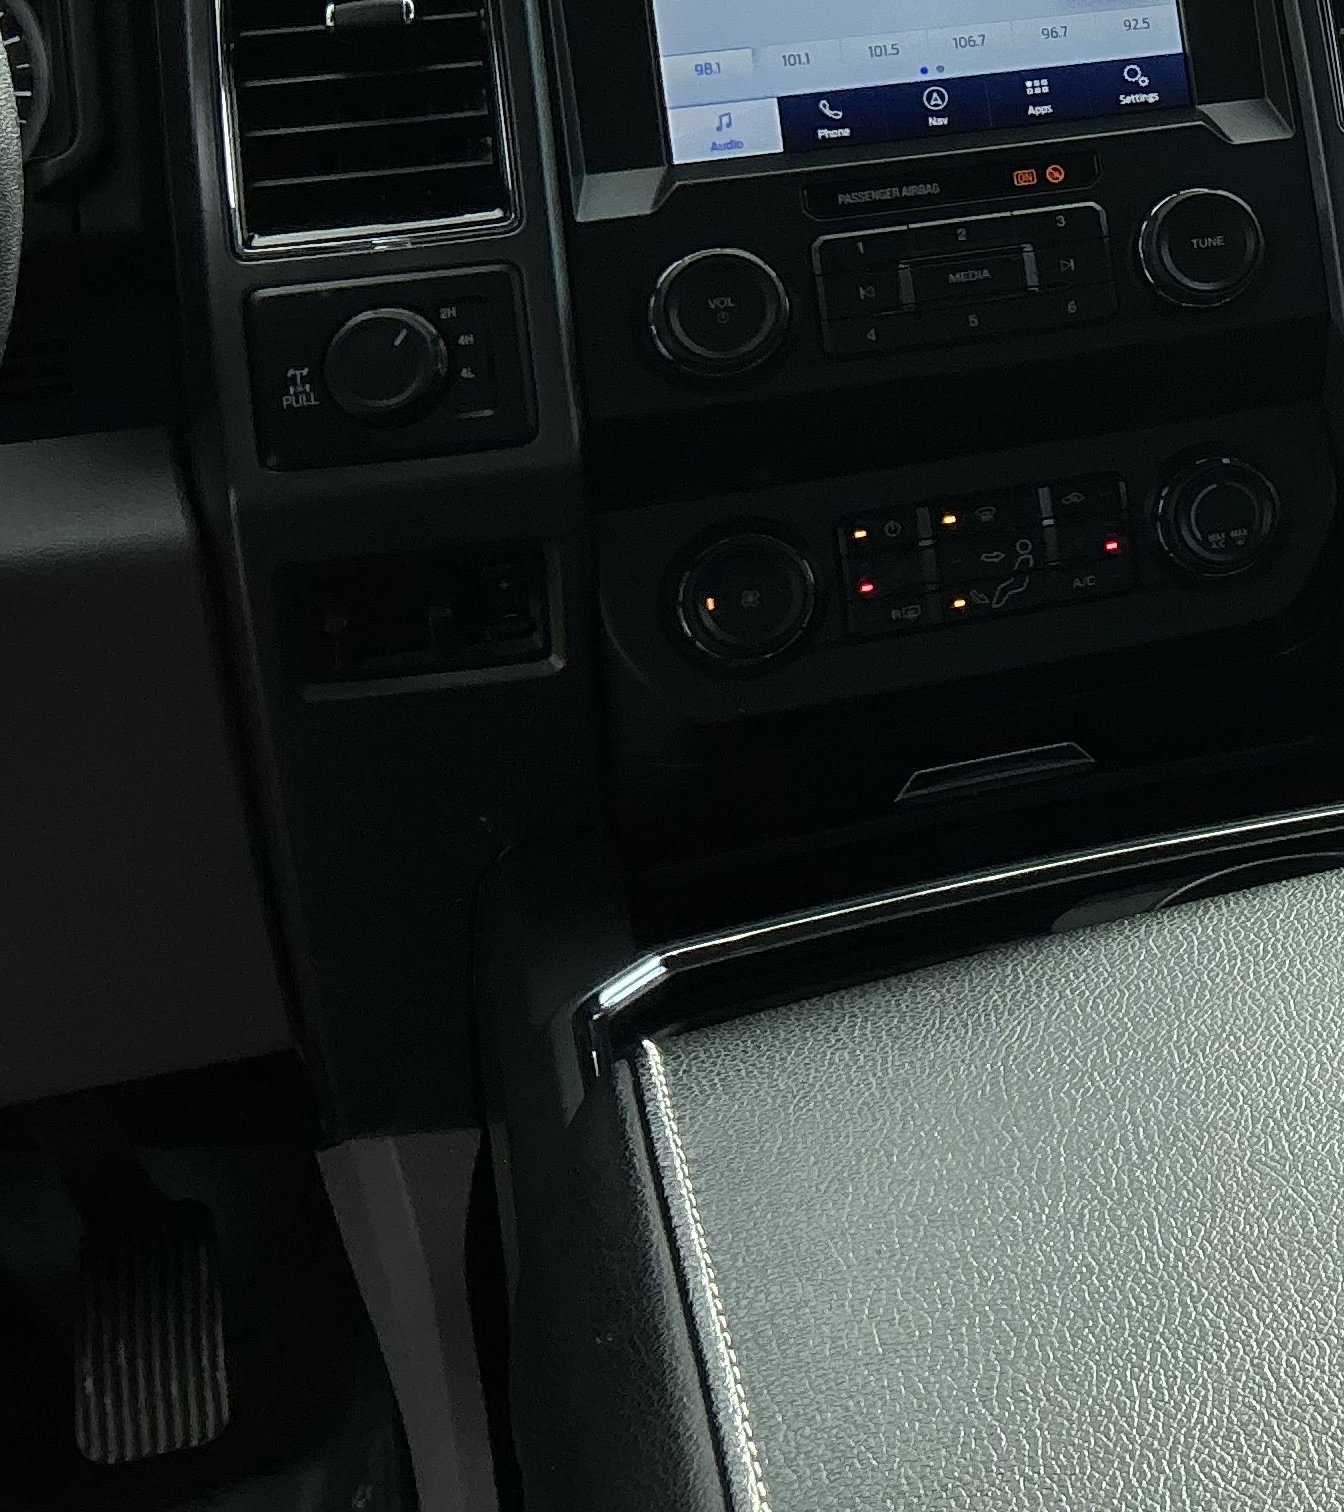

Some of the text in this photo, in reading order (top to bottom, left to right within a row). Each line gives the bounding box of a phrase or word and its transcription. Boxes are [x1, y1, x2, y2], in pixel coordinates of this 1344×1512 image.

[694, 17, 1151, 76] 98.1 101.1 101.5 106.7 96.7 92.5
[1118, 91, 1160, 105] Settings
[1027, 104, 1054, 116] Apps
[928, 115, 949, 127] Nav
[817, 127, 851, 140] Phone
[709, 138, 745, 153] Audio
[837, 182, 941, 206] PASSENGER AIRBAG
[856, 215, 1067, 255] 1 2 3
[1190, 235, 1225, 250] TUNE
[947, 268, 993, 284] MEDIA
[707, 296, 737, 309] VOL
[439, 305, 457, 320] 2H
[866, 299, 1078, 341] 4 5 6
[281, 391, 321, 410] PULL
[1072, 574, 1097, 589] A/C
